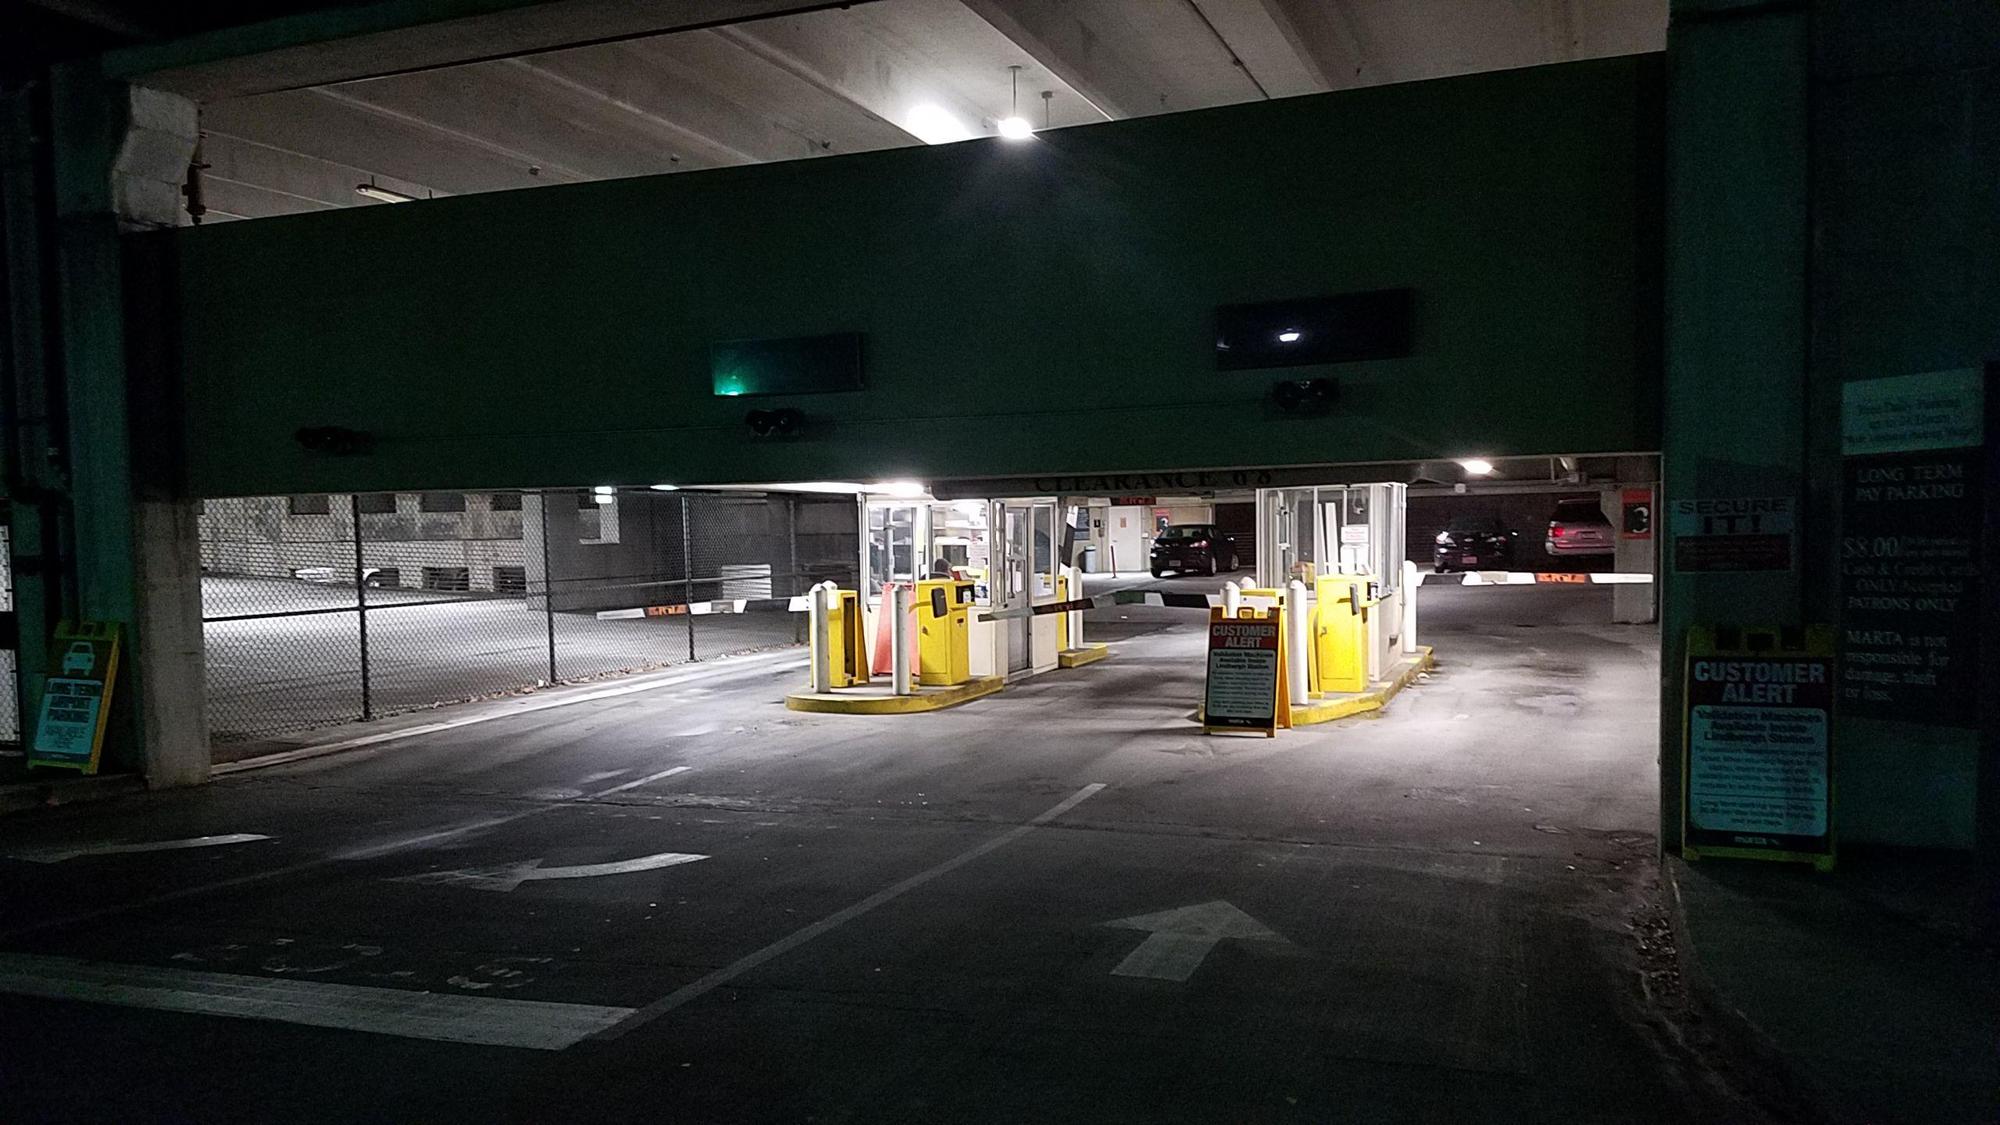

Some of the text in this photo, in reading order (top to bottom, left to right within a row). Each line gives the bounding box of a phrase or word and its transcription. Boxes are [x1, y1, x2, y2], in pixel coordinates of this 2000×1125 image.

[1036, 471, 1218, 492] CLEARANCE
[1857, 464, 1964, 484] LONG TERM
[1855, 484, 1965, 501] PAY PARKING
[1679, 500, 1787, 515] SECURE
[1703, 514, 1761, 533] IT!
[1211, 625, 1276, 637] CUSTOMER
[1846, 629, 1904, 646] MARTA
[1225, 637, 1262, 648] ALERT
[1694, 660, 1826, 684] CUSTOMER
[1721, 683, 1798, 704] ALERT
